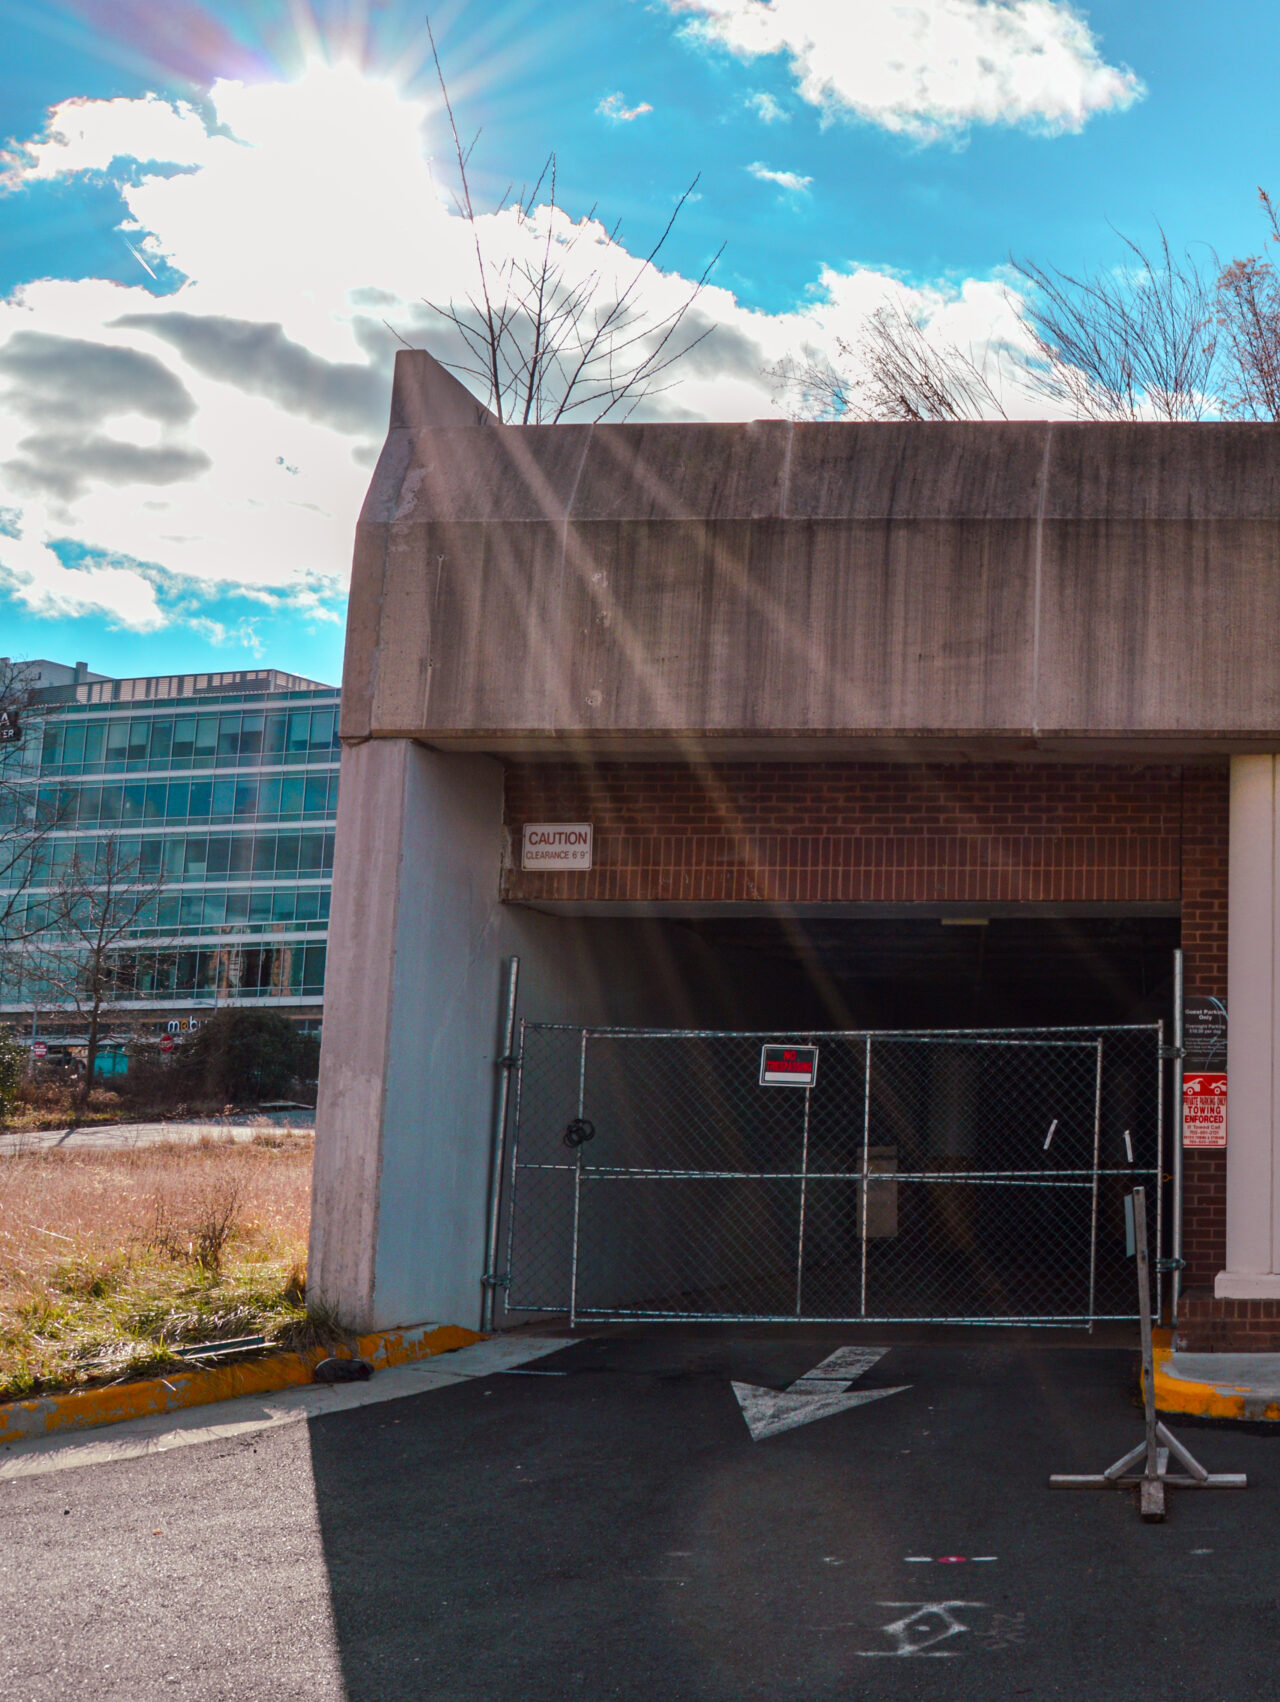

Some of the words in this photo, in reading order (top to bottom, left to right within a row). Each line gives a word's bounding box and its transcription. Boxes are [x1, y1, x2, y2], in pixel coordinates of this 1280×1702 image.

[528, 831, 588, 846] CAUTION
[525, 851, 570, 860] CLEARANCE
[784, 1050, 797, 1061] NO
[766, 1060, 812, 1073] TRESPASSING
[1183, 1096, 1199, 1106] PRIVATE
[1200, 1096, 1216, 1106] PARKING
[1217, 1096, 1226, 1106] ONLY
[1188, 1106, 1221, 1115] TOWING
[1185, 1115, 1224, 1124] ENFORCED
